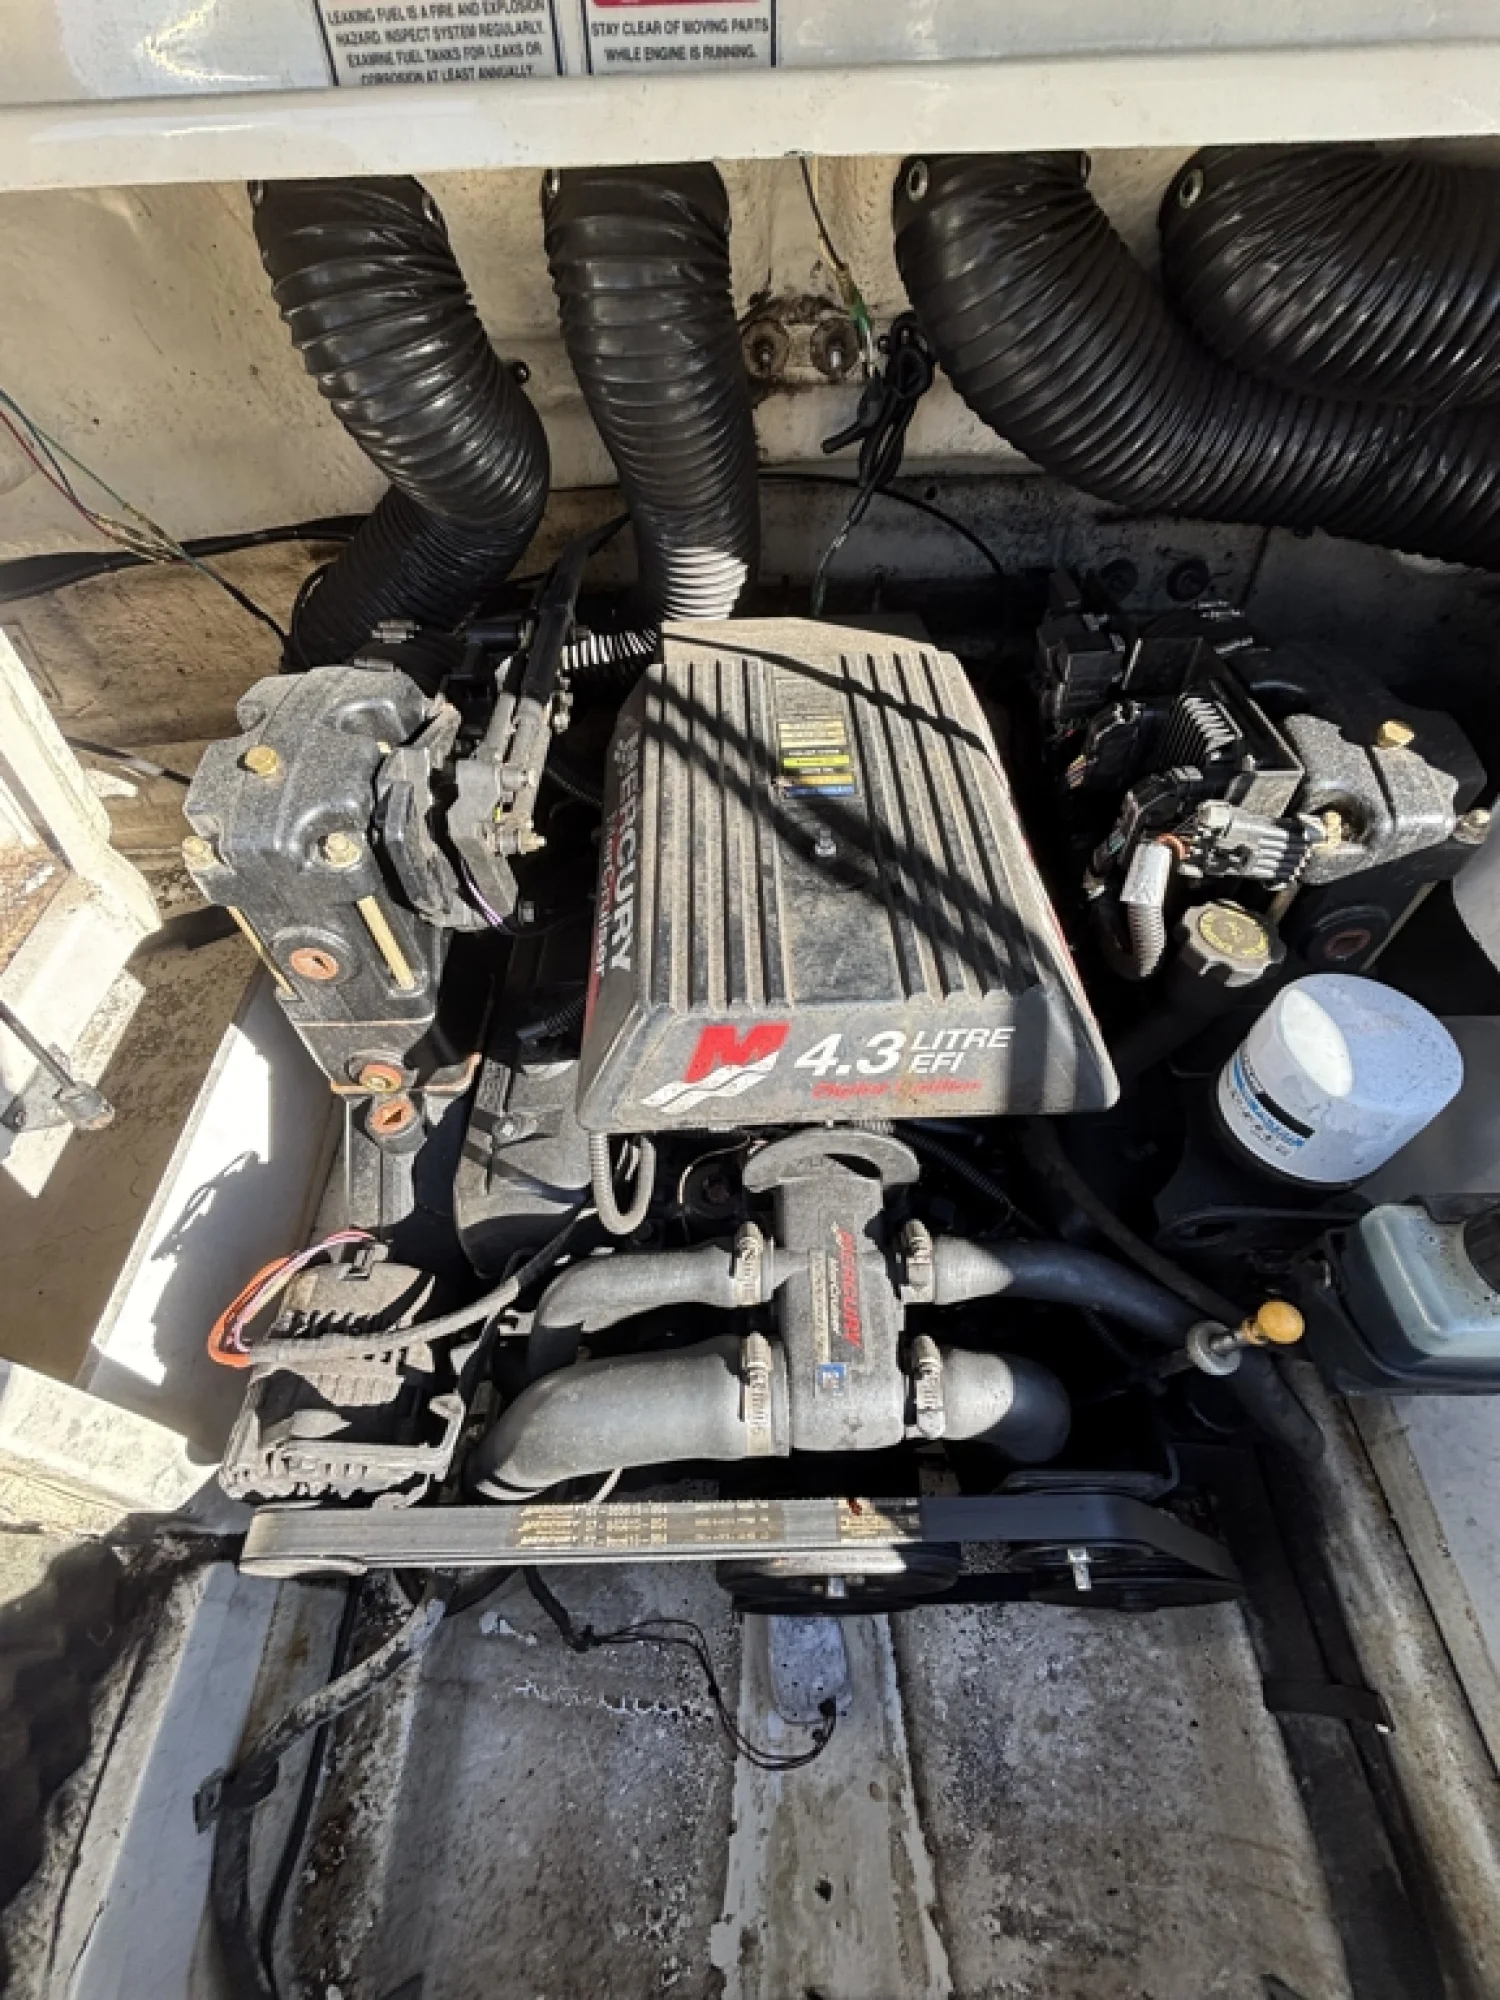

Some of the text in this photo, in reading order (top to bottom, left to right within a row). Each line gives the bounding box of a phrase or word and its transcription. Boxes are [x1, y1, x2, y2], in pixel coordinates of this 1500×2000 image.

[327, 8, 375, 26] LEAKING
[377, 6, 406, 21] FUEL
[429, 4, 456, 19] FIRE
[457, 2, 480, 17] AND
[481, 0, 545, 15] EXPLOSION
[384, 26, 430, 43] INSPECT
[431, 24, 477, 41] SYSTEM
[591, 17, 769, 36] STAY CLEAR OF MOVING PARTS
[346, 41, 543, 67] EXAMINE FUEL TANKS FOR LEAKS OR
[604, 46, 642, 62] WHILE
[644, 45, 687, 62] ENGINE
[689, 45, 702, 61] IS
[426, 69, 438, 83] AT
[441, 66, 475, 83] LEAST
[611, 731, 640, 972] MERCURY
[794, 1025, 1017, 1076] 4.3 LITRE
[907, 1050, 965, 1075] EFI
